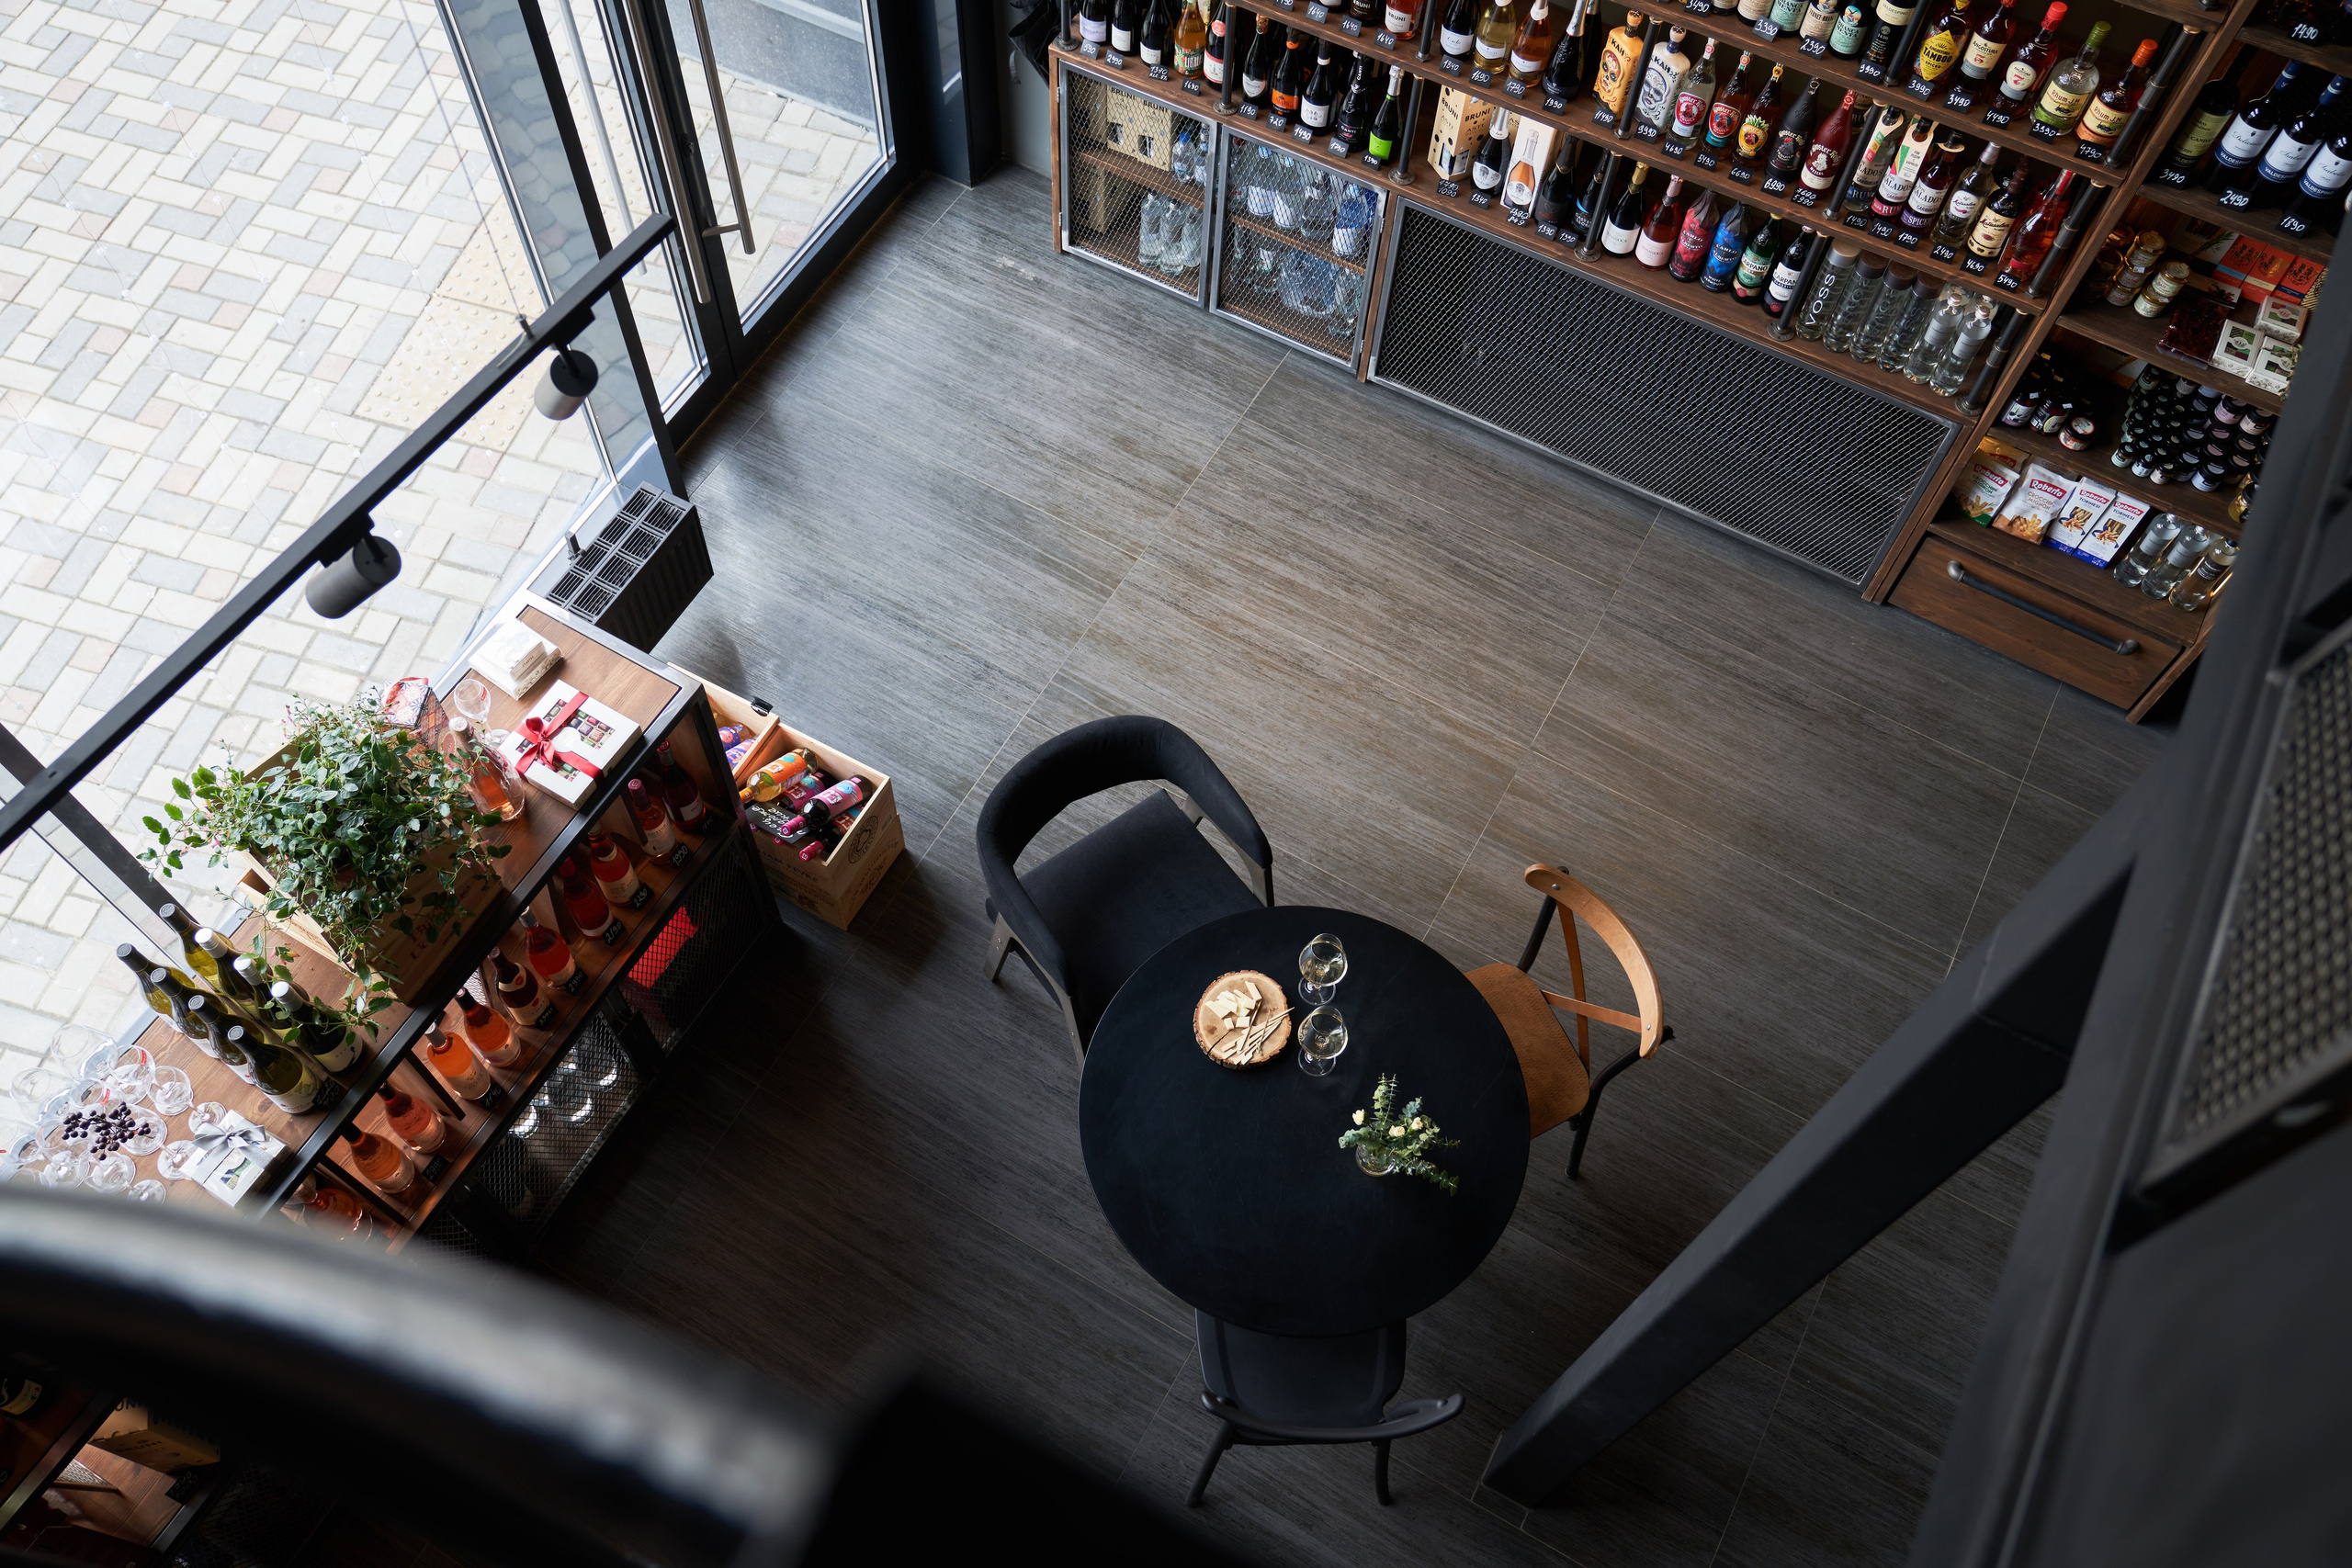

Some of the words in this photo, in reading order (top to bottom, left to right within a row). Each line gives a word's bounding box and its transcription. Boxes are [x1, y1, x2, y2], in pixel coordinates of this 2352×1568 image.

[1353, 0, 1370, 9] BRUNI
[1686, 0, 1709, 12] 3490
[1883, 4, 1909, 15] VALDESPINO
[1309, 6, 1324, 18] 1640
[1388, 11, 1406, 22] BRUNI
[1342, 20, 1358, 31] 1640
[1755, 20, 1778, 35] 3390
[2292, 24, 2318, 39] 1490
[1377, 34, 1394, 45] 1640
[1083, 43, 1096, 55] 590
[1611, 38, 1624, 56] KAH
[1800, 39, 1825, 55] 2390
[1973, 41, 1998, 54] ANGOSTURA
[1107, 54, 1123, 66] 2990
[1923, 47, 1952, 62] TAMBOO
[1974, 54, 1985, 64] 5
[1443, 60, 1459, 70] 1840
[1655, 56, 1670, 73] KAH
[1471, 70, 1490, 82] 1690
[2013, 74, 2024, 85] 7
[1184, 81, 1199, 90] 1690
[1507, 81, 1525, 94] 1790
[1909, 80, 1930, 95] 3990
[1947, 94, 1971, 107] 3490
[2051, 90, 2067, 102] Rhum
[1143, 101, 1168, 112] BRUNI
[1442, 98, 1459, 120] BRUNI
[1545, 98, 1562, 108] 1990
[1240, 105, 1255, 116] 1190
[1465, 108, 1490, 122] BRUNI
[2094, 106, 2109, 121] Rhum
[1269, 116, 1284, 127] 720
[1594, 111, 1614, 123] 11490
[1986, 110, 2009, 124] 4490
[1295, 127, 1312, 140] 1490
[1467, 124, 1484, 133] ASTI
[1331, 142, 1346, 153] 1790
[1665, 142, 1683, 155] 4690
[2080, 144, 2102, 158] 4790
[1364, 155, 1378, 165] 1390
[1697, 154, 1715, 167] 5490
[2221, 152, 2251, 164] VALDESPINO
[1731, 168, 1750, 180] 6690
[1858, 164, 1883, 176] LADOS
[2160, 169, 2185, 183] 3490
[2265, 167, 2296, 179] VALDESPINO
[1764, 178, 1786, 192] 6990
[2304, 179, 2334, 195] VALDESPINO
[1439, 187, 1456, 197] 1090
[1472, 194, 1488, 204] 1340
[1793, 194, 1813, 206] 5990
[2220, 190, 2249, 207] 2490
[1508, 217, 1523, 226] 849
[1847, 215, 1867, 226] 1490
[1980, 219, 2009, 228] Matusalem
[2281, 217, 2306, 232] 1890
[1538, 224, 1555, 236] 1390
[1683, 230, 1703, 242] CARLO
[1873, 223, 1892, 237] 1490
[1560, 232, 1576, 243] 1390
[1898, 232, 1918, 244] 1790
[1716, 243, 1737, 254] CARLO
[1934, 246, 1954, 259] 2490
[1743, 254, 1768, 271] CARPANO
[1966, 259, 1984, 271] 4690
[1774, 271, 1796, 284] CARPAN
[1997, 275, 2018, 288] 5490
[1805, 274, 1835, 325] VOSS
[1975, 465, 2005, 485] Roberto
[2031, 480, 2064, 497] Roberto
[2028, 491, 2053, 505] CROCCHIN
[2080, 497, 2101, 508] TORINESI
[2081, 490, 2107, 504] Roberto
[2028, 498, 2050, 510] MIGNON
[2115, 502, 2142, 515] Roberto
[2113, 508, 2135, 520] TORINESI
[673, 845, 688, 866] 1990
[787, 863, 818, 883] FEVRE
[633, 888, 647, 906] 2290
[606, 921, 622, 943] 2190
[568, 973, 583, 993] 2990
[426, 1158, 443, 1181] 2990
